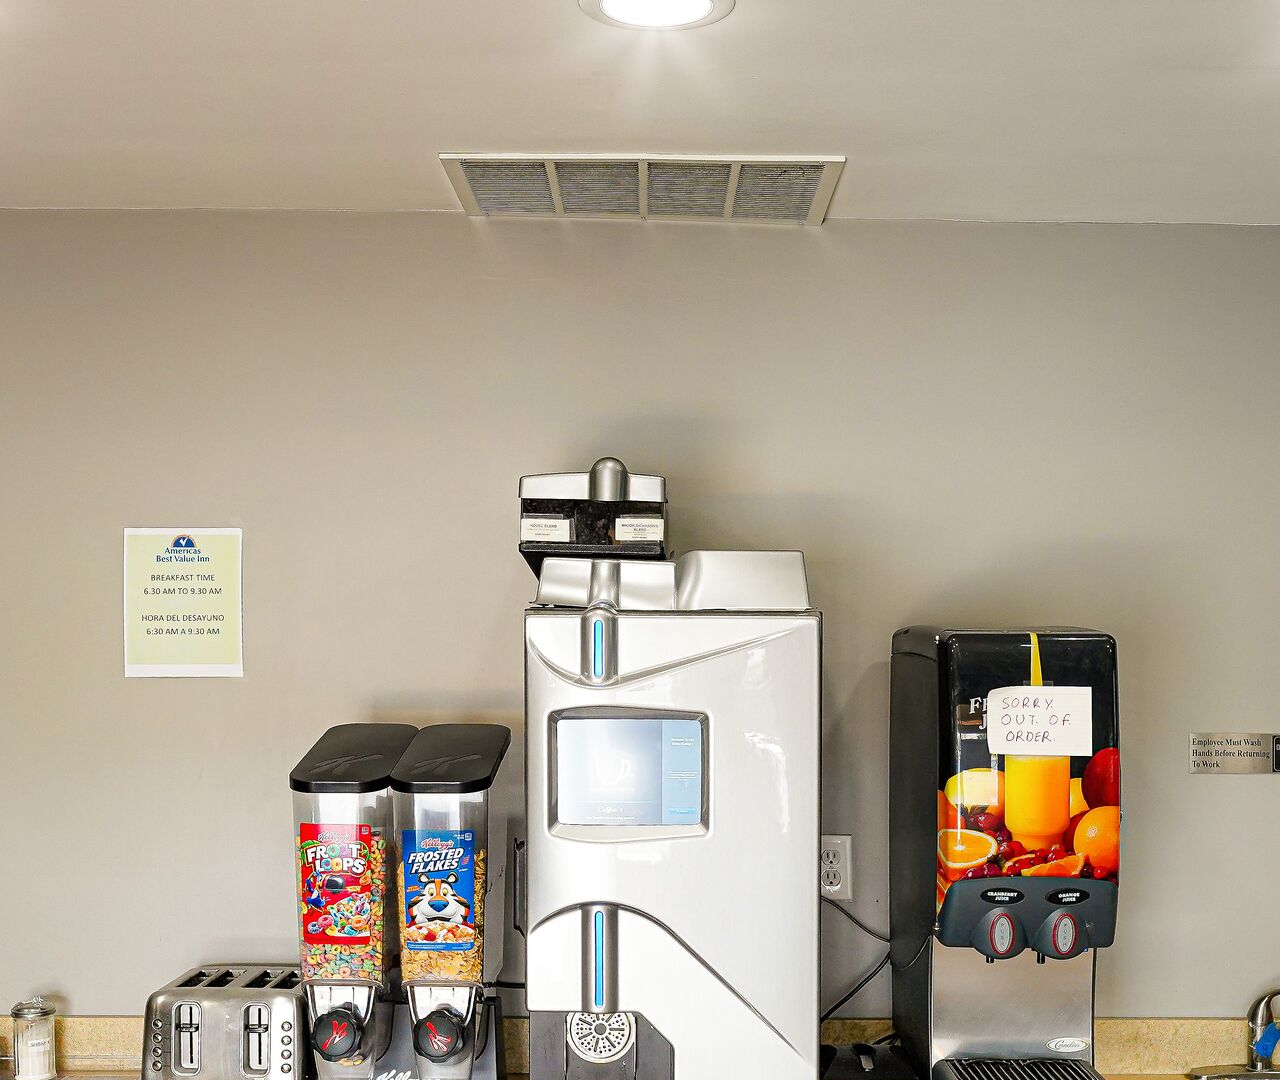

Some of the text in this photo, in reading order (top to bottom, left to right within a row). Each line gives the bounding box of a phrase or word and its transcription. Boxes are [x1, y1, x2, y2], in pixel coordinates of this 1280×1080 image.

[150, 574, 215, 582] BREAKFAST TIME
[142, 614, 224, 622] HORA DEL DESAYUNO
[1192, 738, 1262, 748] Employee Must Wash
[1192, 749, 1270, 759] Hands Before Returning
[1192, 760, 1220, 768] To Work
[306, 843, 361, 863] FROT
[407, 847, 464, 864] FROSTED
[315, 858, 366, 874] LOOPS
[410, 858, 459, 874] FLAKES
